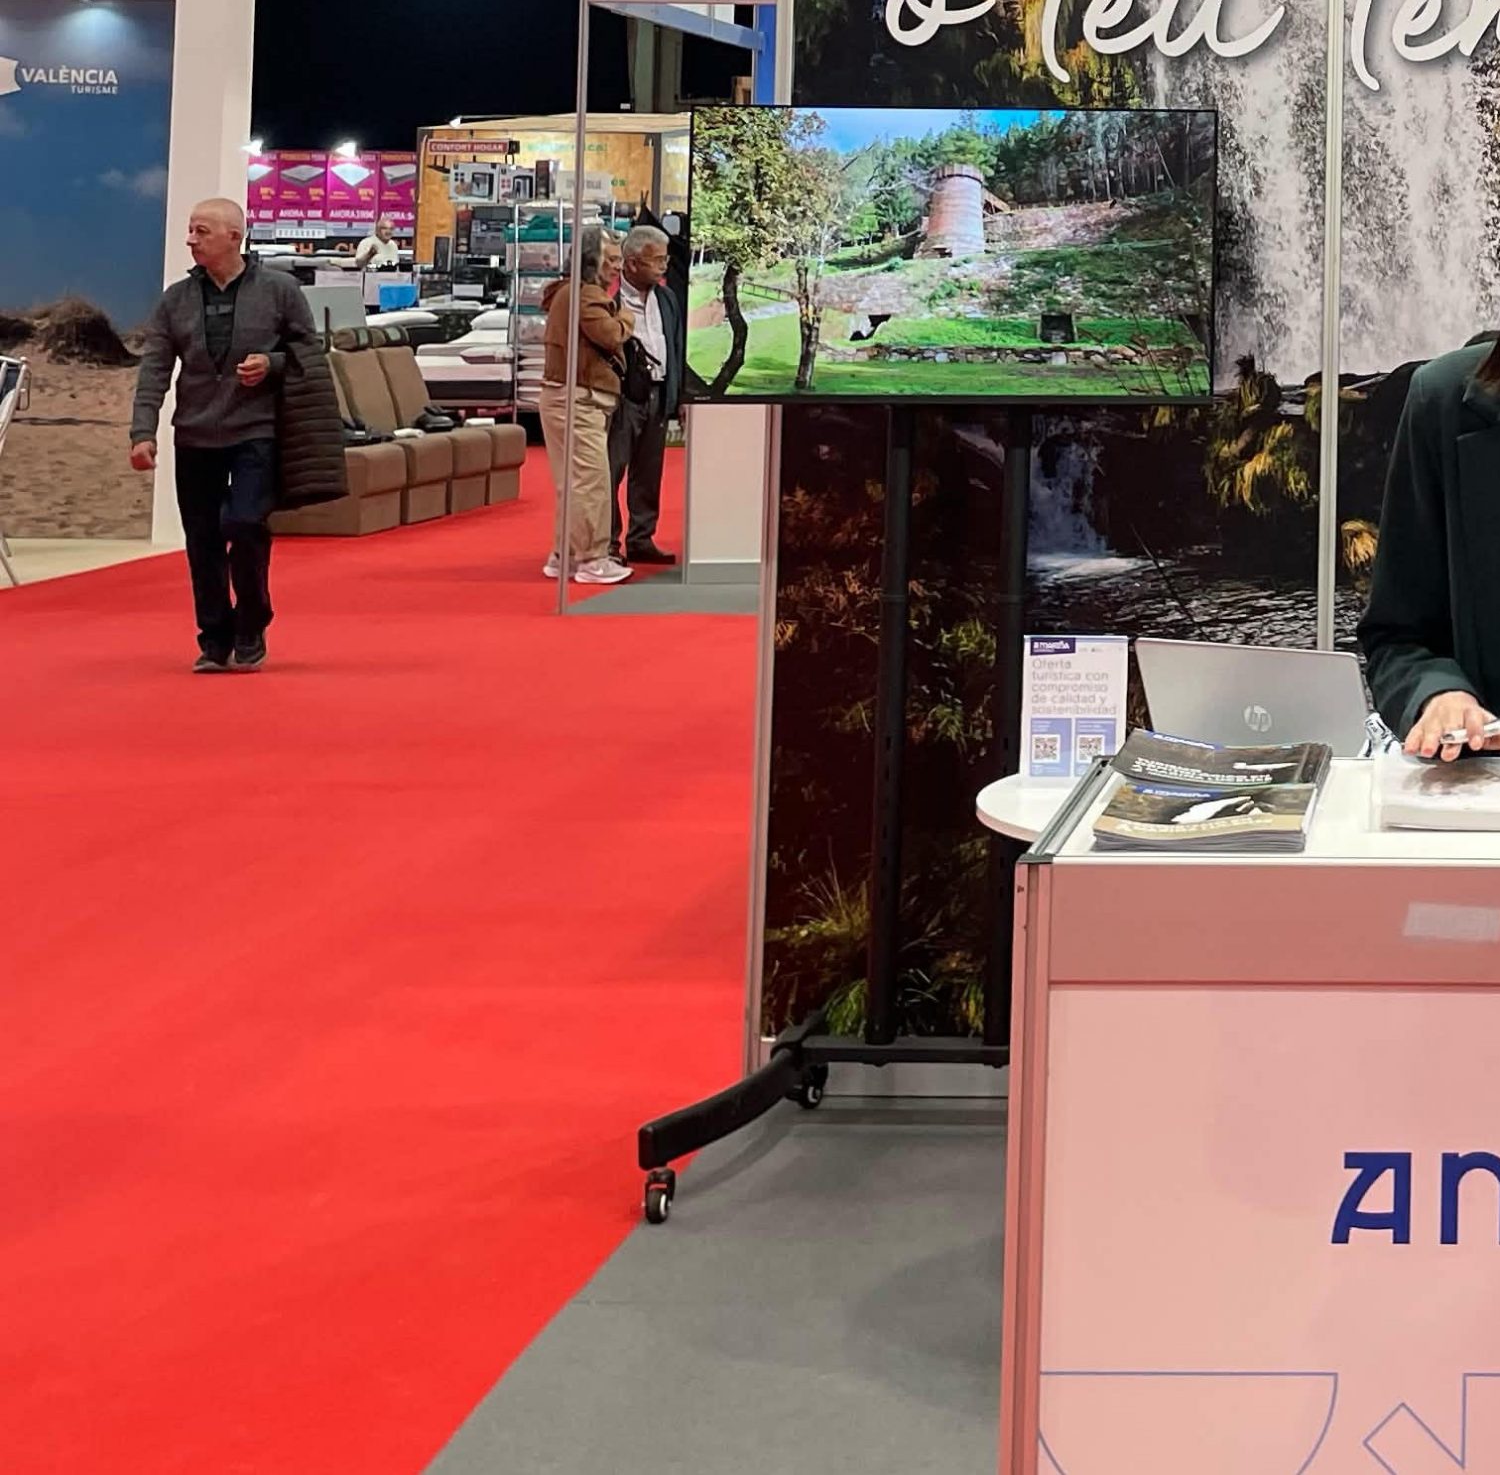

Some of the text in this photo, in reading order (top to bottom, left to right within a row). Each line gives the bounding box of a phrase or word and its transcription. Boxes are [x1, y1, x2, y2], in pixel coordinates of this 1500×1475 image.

[21, 65, 118, 85] VALÈNCIA
[71, 86, 118, 95] TURISME
[430, 142, 504, 152] CONFORT HOGAR
[1085, 672, 1109, 681] con
[1331, 1152, 1412, 1244] A
